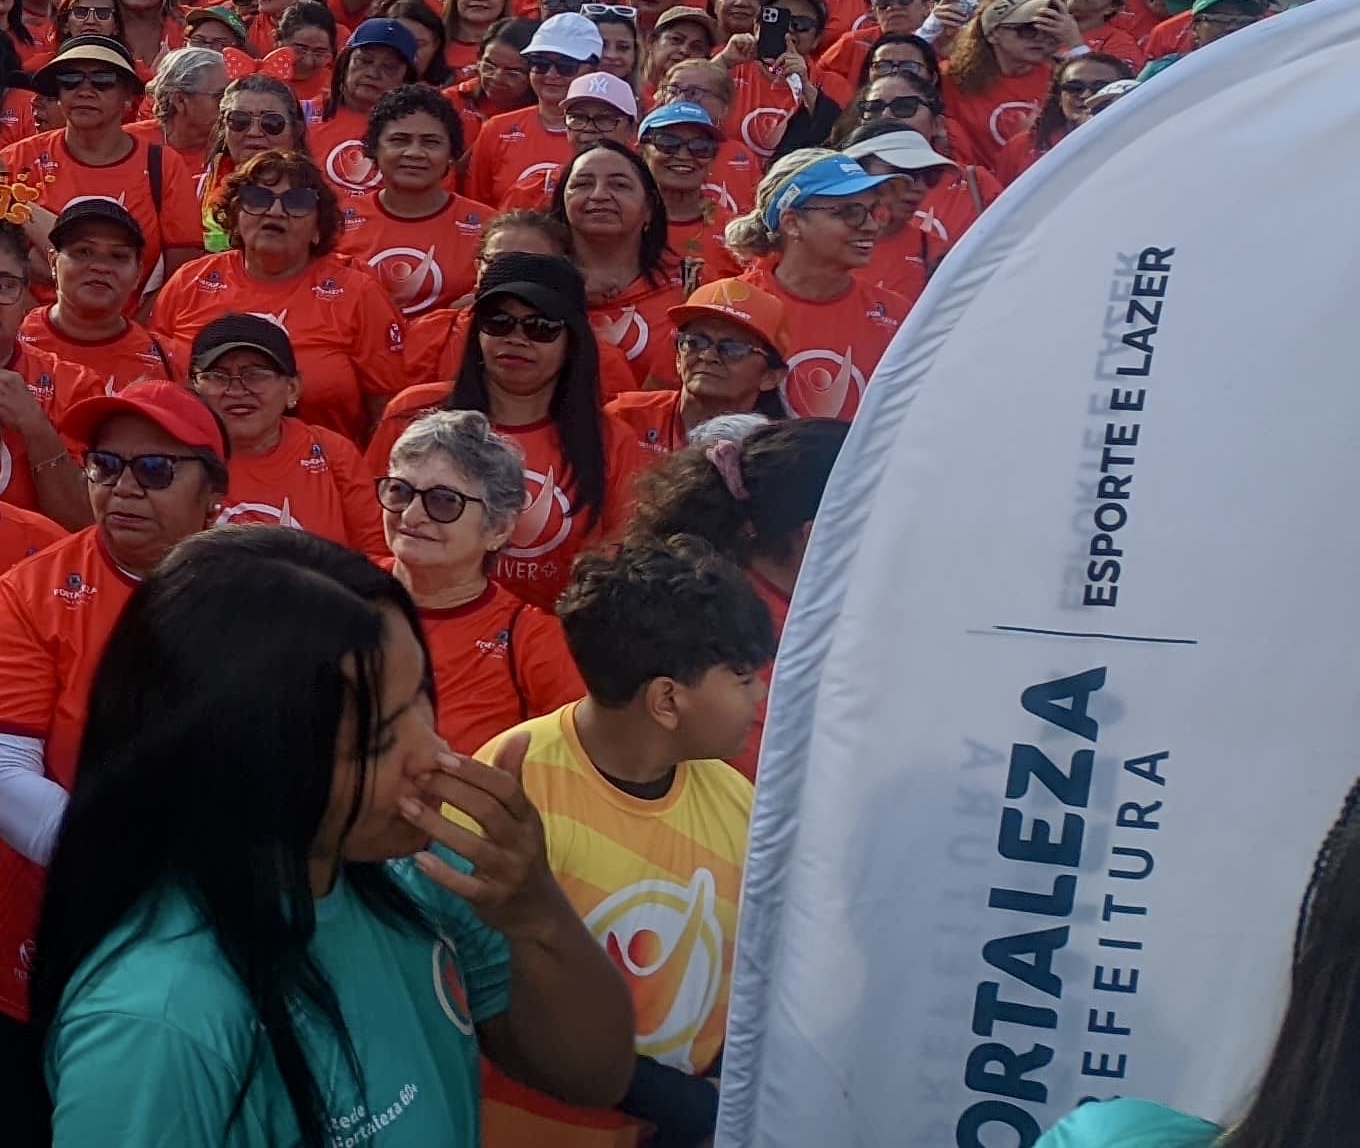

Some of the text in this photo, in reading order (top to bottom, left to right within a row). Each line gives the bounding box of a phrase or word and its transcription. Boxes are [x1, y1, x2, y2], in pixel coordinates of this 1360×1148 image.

[1082, 245, 1177, 608] ESPORTE E LAZER
[955, 666, 1108, 1148] ORTALEZA
